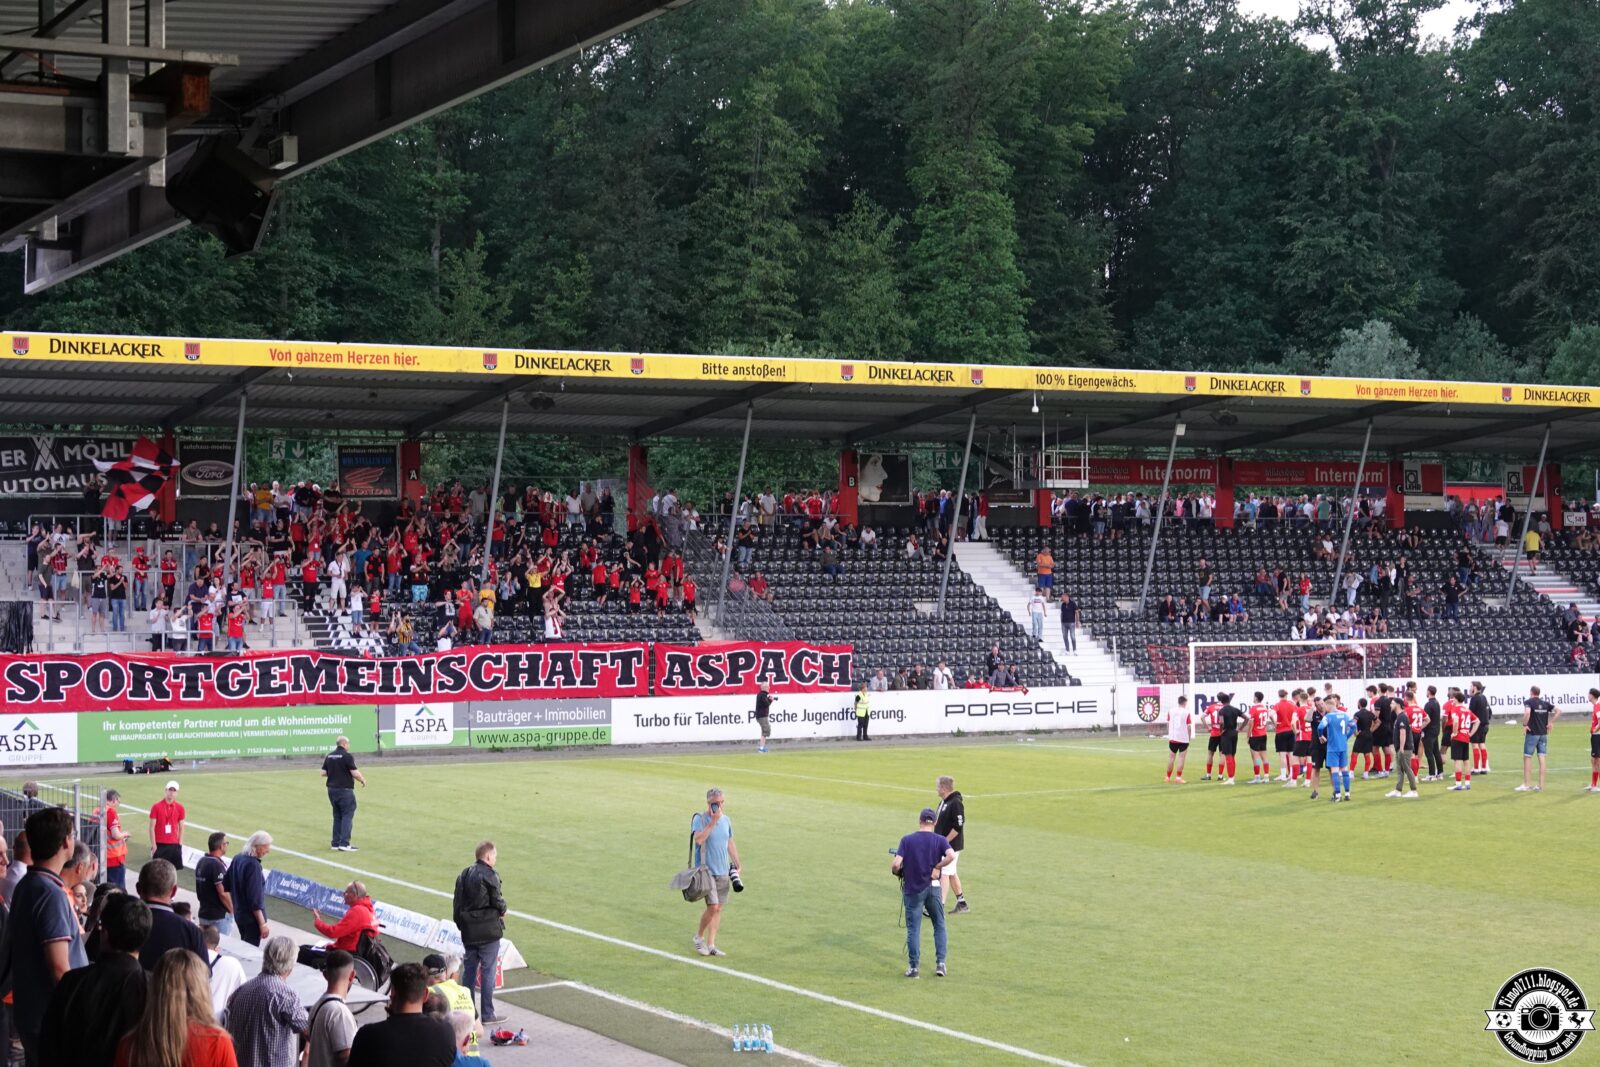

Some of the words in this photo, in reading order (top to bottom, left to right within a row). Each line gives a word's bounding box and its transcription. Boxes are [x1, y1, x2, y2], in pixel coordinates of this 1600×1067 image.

[49, 338, 164, 358] DINKELACKER
[269, 348, 291, 361] Von
[296, 350, 342, 364] ganzem
[347, 350, 390, 365] Herzen
[394, 352, 420, 366] hier.
[514, 354, 614, 373] DINKELACKER
[702, 363, 728, 375] Bitte
[732, 364, 786, 378] anstoßen!
[868, 365, 955, 382] DINKELACKER
[1035, 374, 1052, 385] 100
[1054, 374, 1065, 385] %
[1068, 375, 1136, 389] Eigengewächs.
[1209, 377, 1287, 394] DINKELACKER
[1355, 385, 1371, 396] Von
[1374, 386, 1406, 399] ganzem
[1409, 386, 1438, 399] Herzen
[1440, 387, 1459, 399] hier.
[1523, 388, 1592, 403] DINKELACKER
[63, 440, 137, 462] MÖHL
[196, 465, 225, 480] Ford
[410, 469, 417, 480] A
[1140, 465, 1210, 481] Intenorm
[0, 472, 108, 494] UTOHAUS
[848, 477, 855, 486] B
[6, 648, 644, 703] SPORTGEMEINSCHAFT
[661, 647, 852, 689] ASPACH
[1490, 696, 1504, 706] Du
[1557, 693, 1589, 705] allein.
[476, 709, 532, 726] Bauträger
[534, 712, 542, 721] +
[545, 706, 606, 722] Immobilien
[945, 700, 1098, 717] PORSCHE
[103, 721, 116, 731] Ihr
[119, 720, 180, 734] kompetenter
[183, 718, 218, 730] Partner
[220, 718, 242, 728] rund
[244, 719, 259, 727] um
[261, 716, 276, 726] die
[278, 714, 352, 726] Wohnimmobilie!
[401, 718, 448, 733] ASPA
[633, 713, 671, 727] Turbo
[673, 711, 692, 726] für
[696, 710, 744, 725] Talente.
[748, 709, 797, 724] Psche
[801, 708, 907, 725] Jugendföerung.
[1259, 711, 1267, 726] 13
[110, 733, 163, 742] NEUBAUPROJEKTE
[168, 731, 239, 740] GEBRAUCHTIMMOBILIEN
[243, 729, 288, 738] VERMIETUNGEN
[292, 727, 343, 736] FINANZBERATUNG
[1339, 722, 1346, 735] 1
[0, 733, 57, 752] ASPA
[476, 728, 607, 746] www.aspa-gruppe.de
[8, 754, 43, 762] GRUPPE
